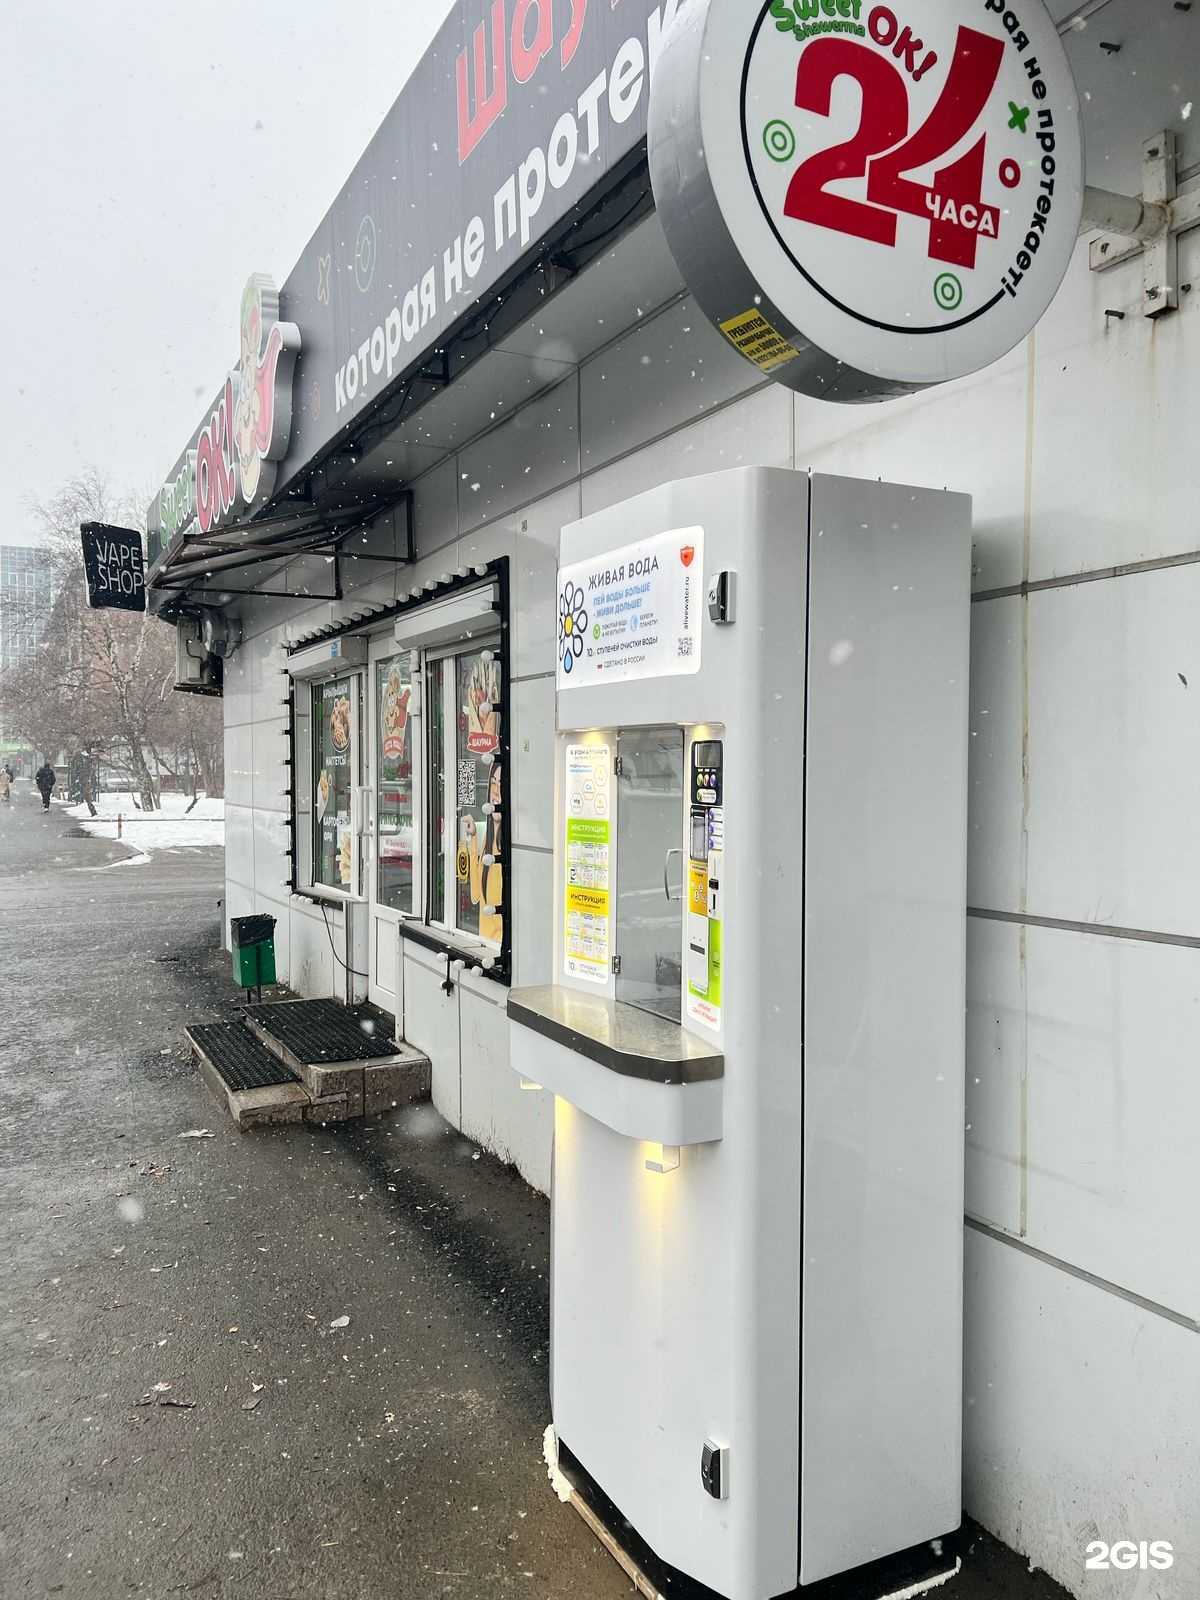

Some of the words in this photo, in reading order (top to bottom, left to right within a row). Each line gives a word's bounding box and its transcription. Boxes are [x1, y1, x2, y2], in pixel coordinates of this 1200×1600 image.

[793, 20, 865, 41] Shawerma
[868, 5, 938, 81] OK!
[1023, 57, 1047, 100] не
[784, 25, 1005, 269] 24
[925, 193, 995, 236] ЧАСА
[1000, 109, 1055, 297] протекает!
[335, 265, 436, 412] которая
[443, 216, 485, 303] не
[96, 539, 141, 571] VAPE
[588, 565, 625, 592] ЖИВАЯ
[628, 555, 659, 578] ВОДА
[98, 565, 144, 596] SHOP
[593, 593, 605, 606] ПЕЙ
